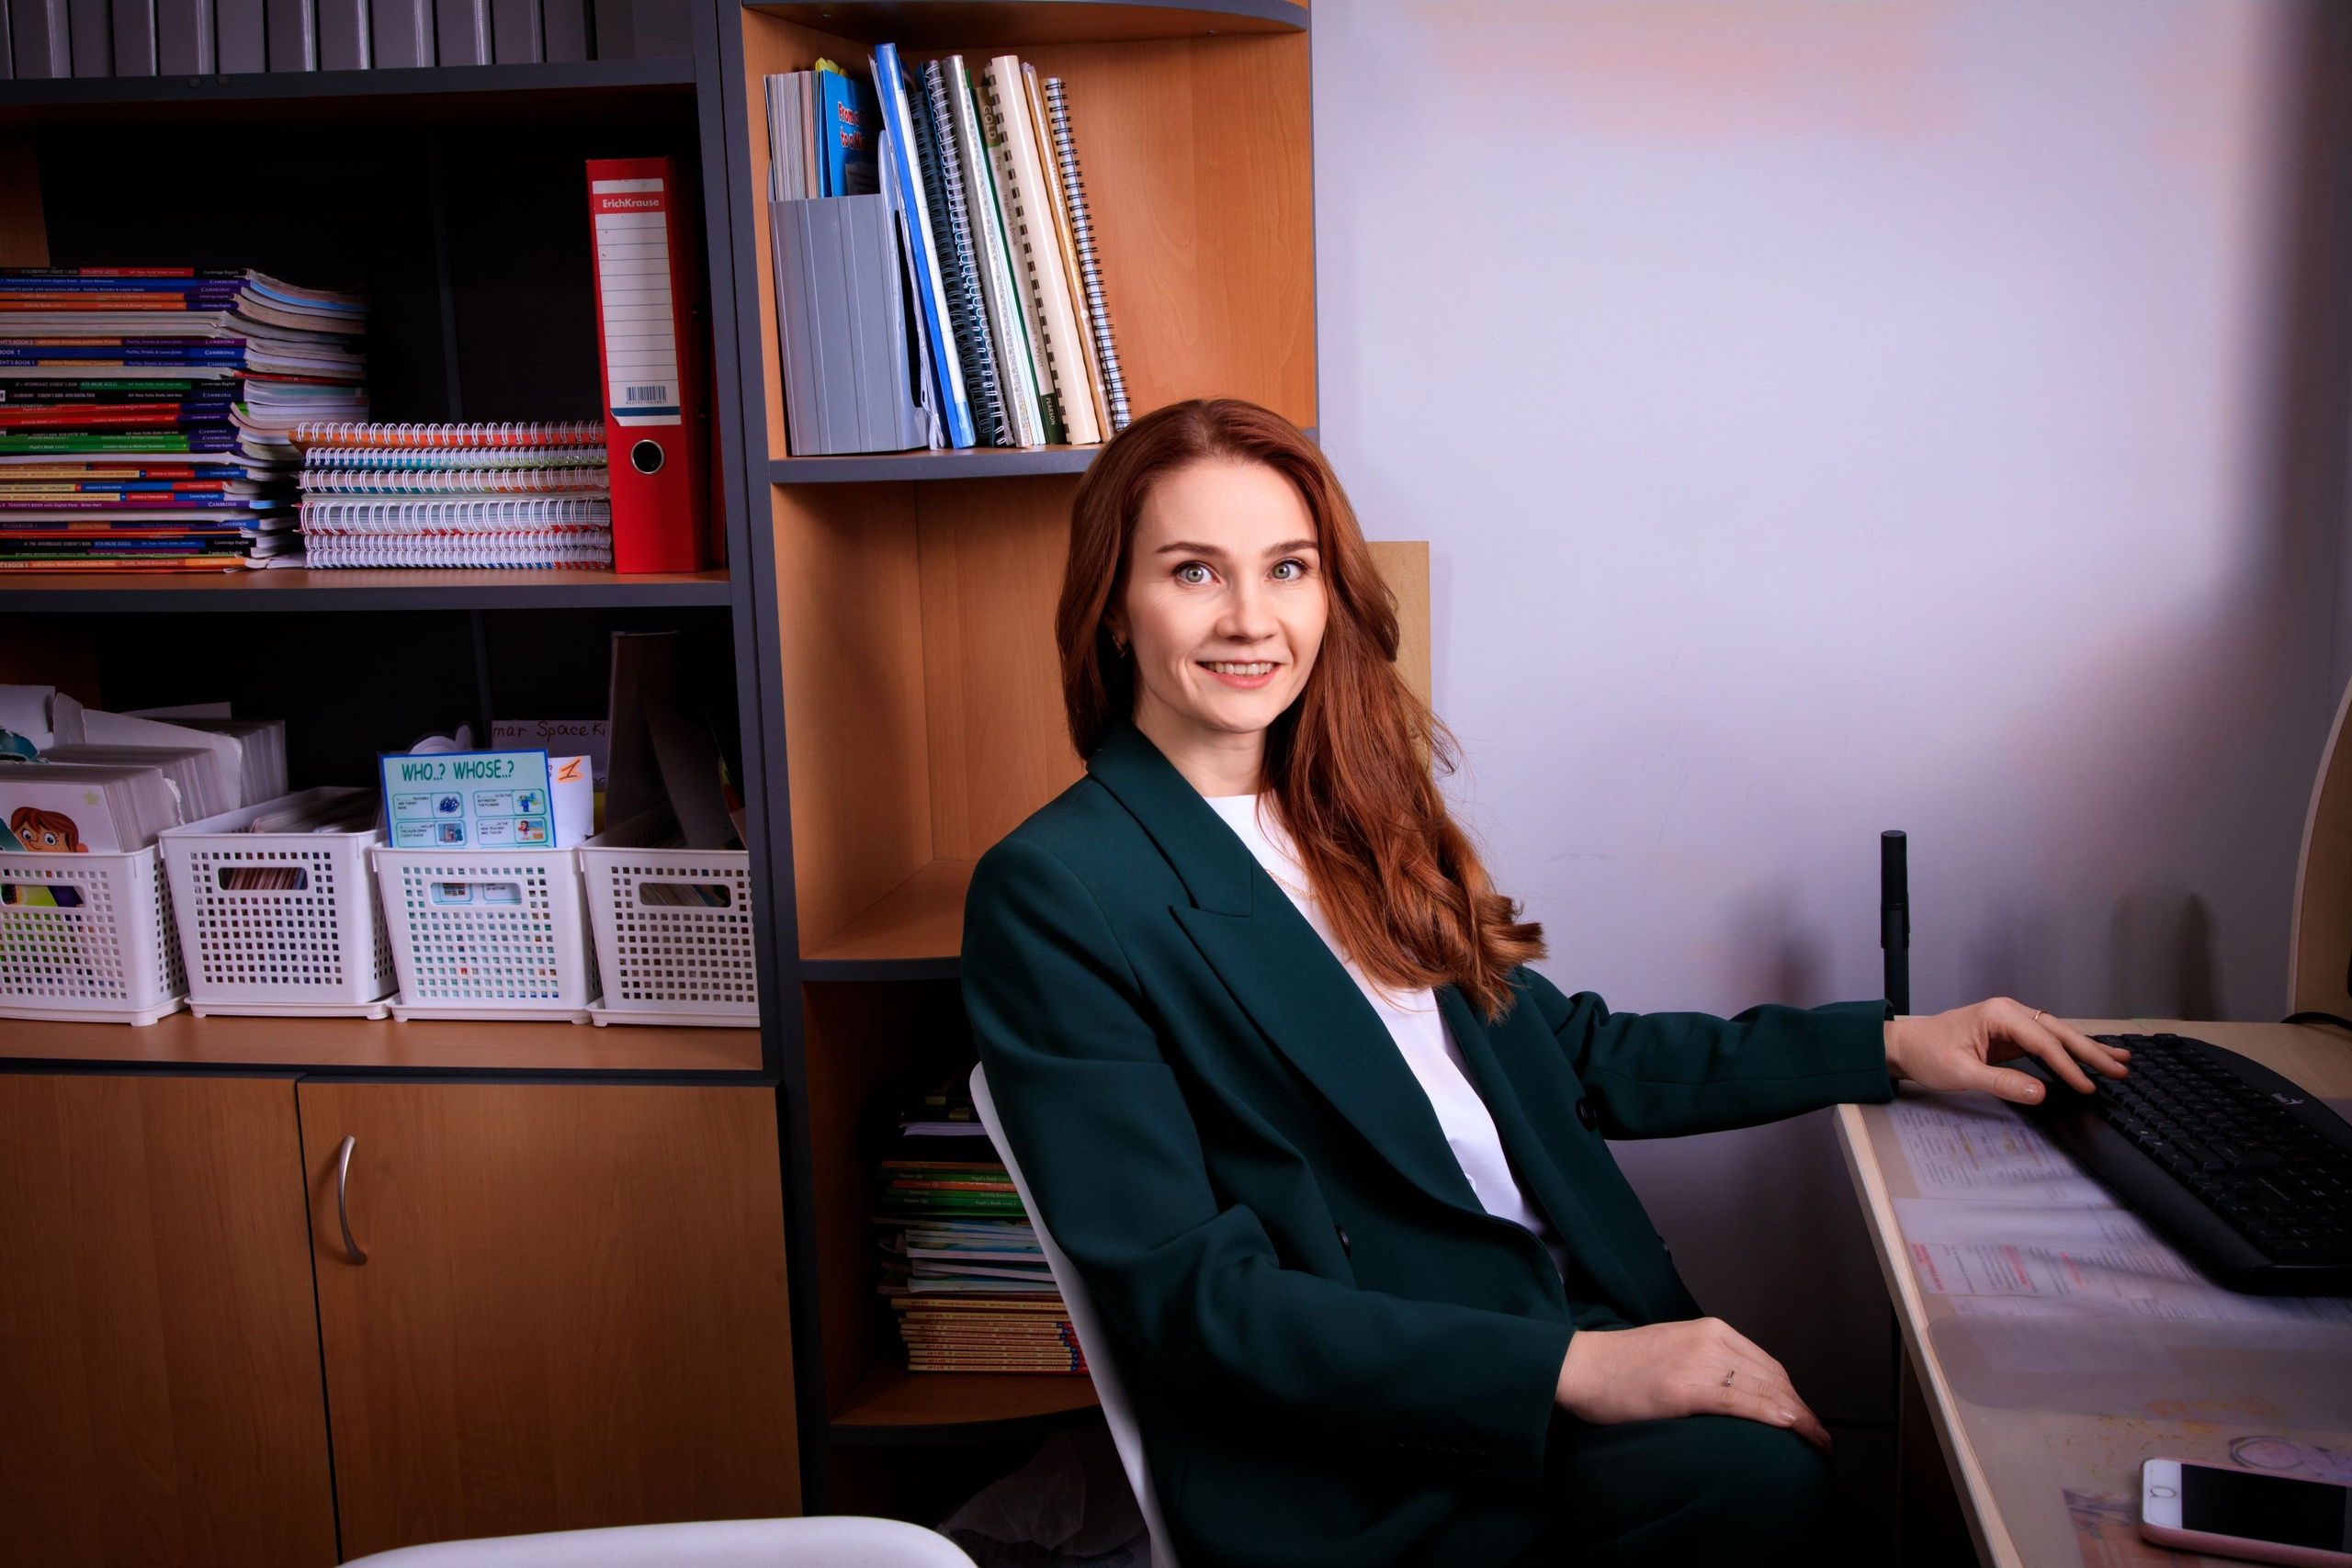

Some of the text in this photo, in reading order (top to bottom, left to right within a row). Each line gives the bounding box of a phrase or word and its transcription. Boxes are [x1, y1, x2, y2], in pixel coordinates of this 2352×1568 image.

[838, 101, 860, 127] From a
[840, 125, 854, 150] to a
[603, 199, 659, 208] ErichKrause
[983, 105, 996, 139] GOLD
[1003, 194, 1014, 226] teacher's
[1026, 305, 1036, 335] Annabell
[1046, 397, 1056, 425] PEARSON
[493, 721, 605, 743] mar Space Ki
[401, 759, 514, 781] WHO..? WHOSE..?
[559, 760, 580, 780] 1
